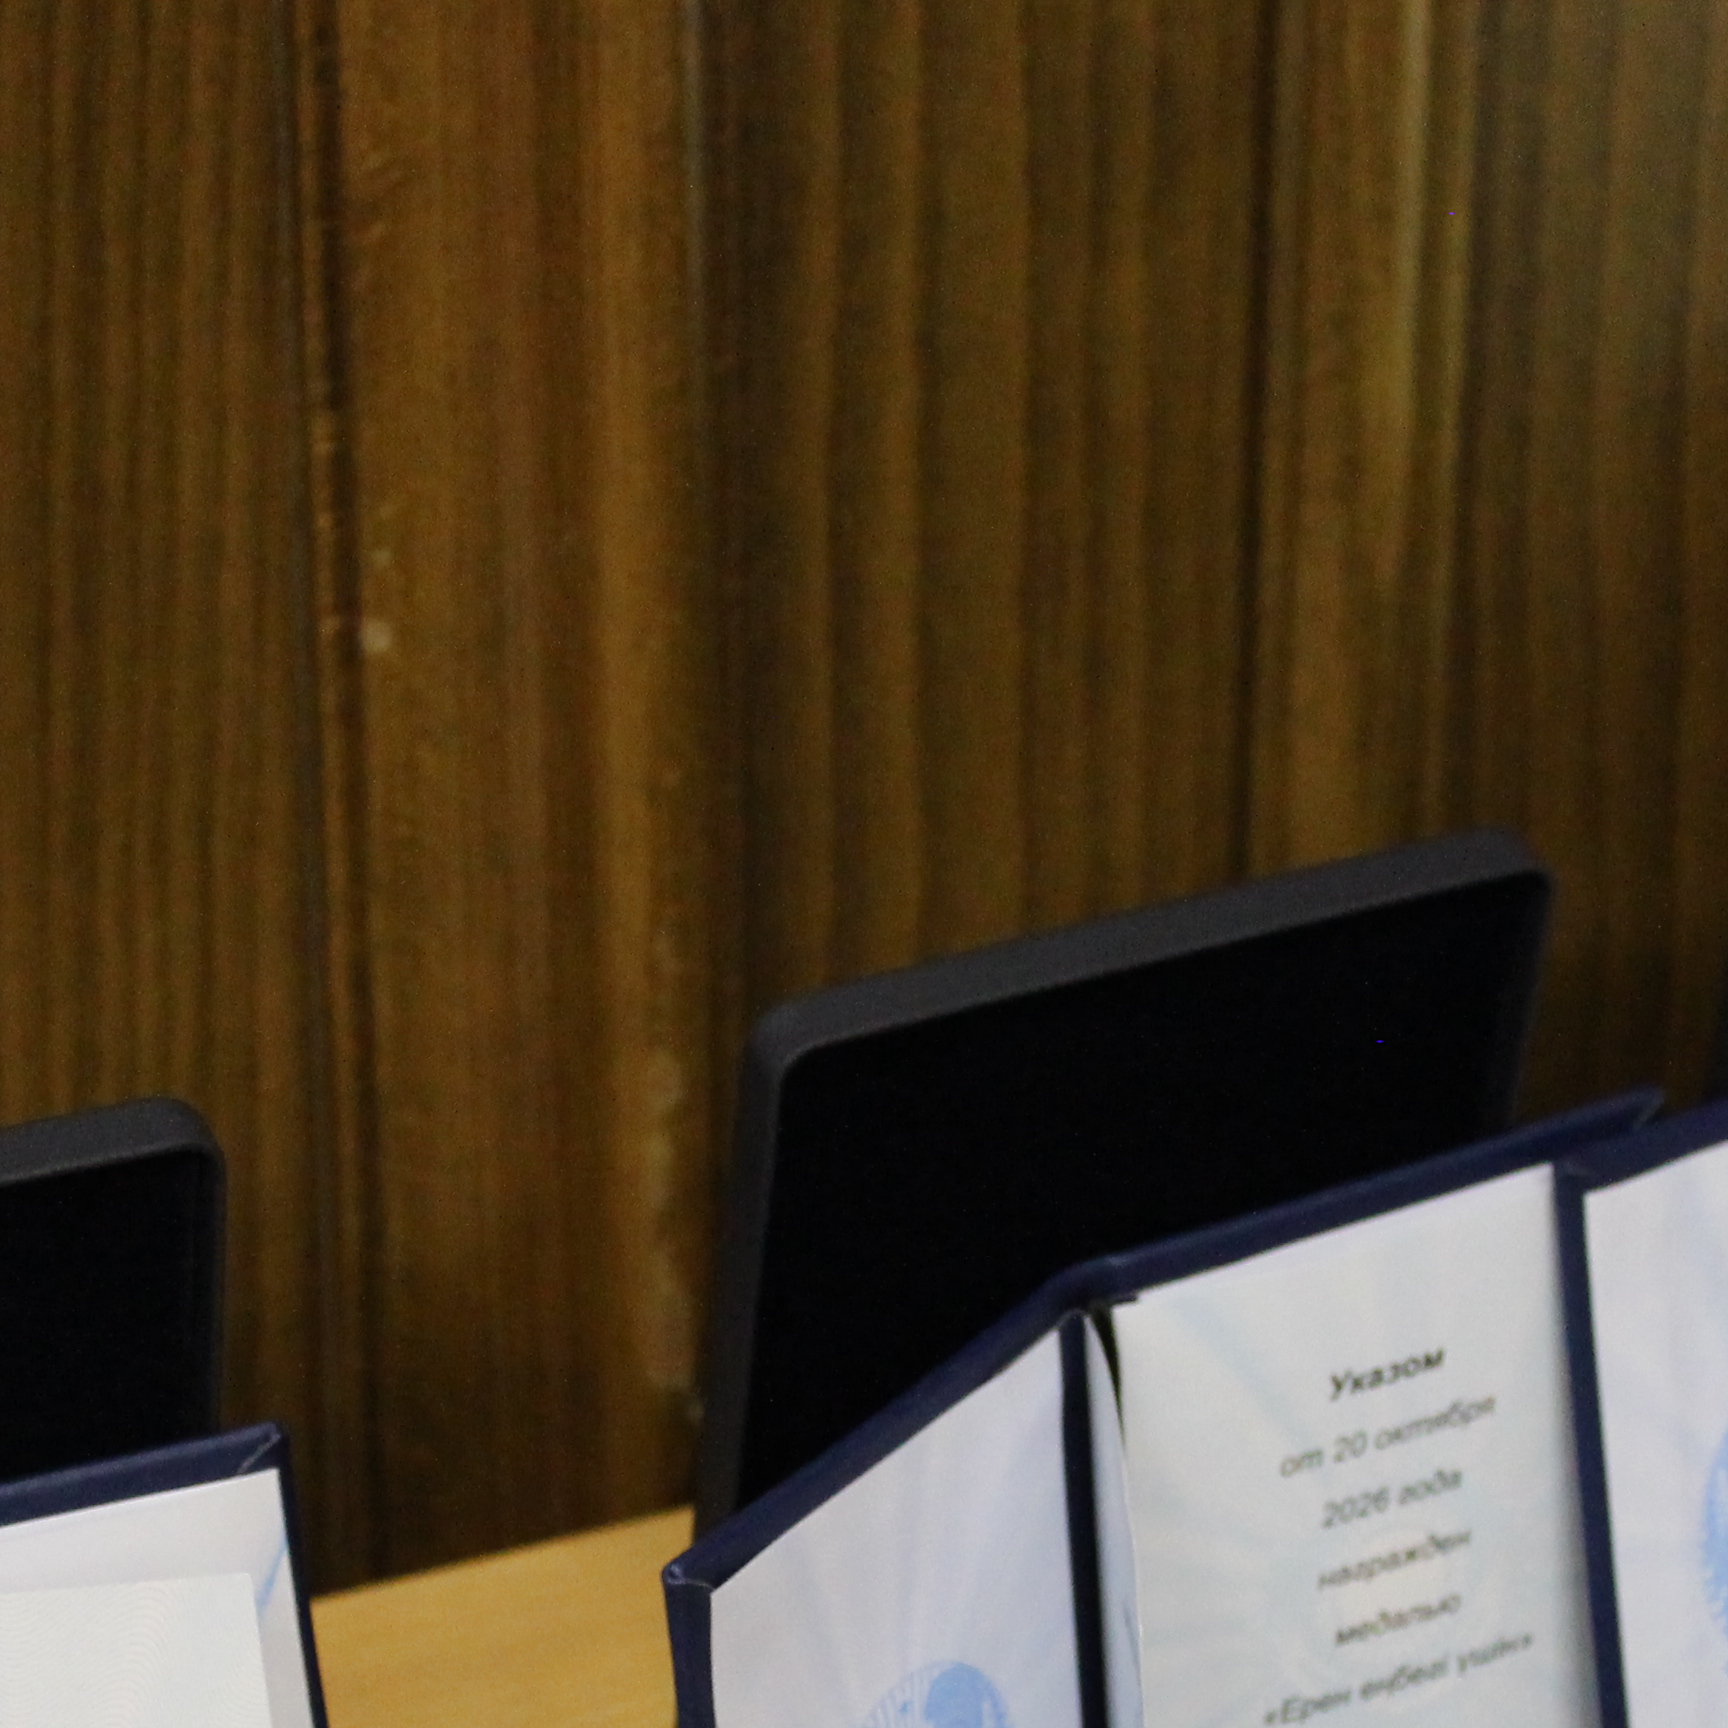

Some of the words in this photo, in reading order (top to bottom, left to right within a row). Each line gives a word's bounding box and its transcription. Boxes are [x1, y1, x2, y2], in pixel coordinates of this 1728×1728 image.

[1328, 1346, 1447, 1403] Указом
[1278, 1448, 1325, 1478] от
[1332, 1430, 1369, 1464] 20
[1373, 1395, 1497, 1451] октября
[1321, 1485, 1391, 1530] 2026
[1397, 1467, 1464, 1507] года
